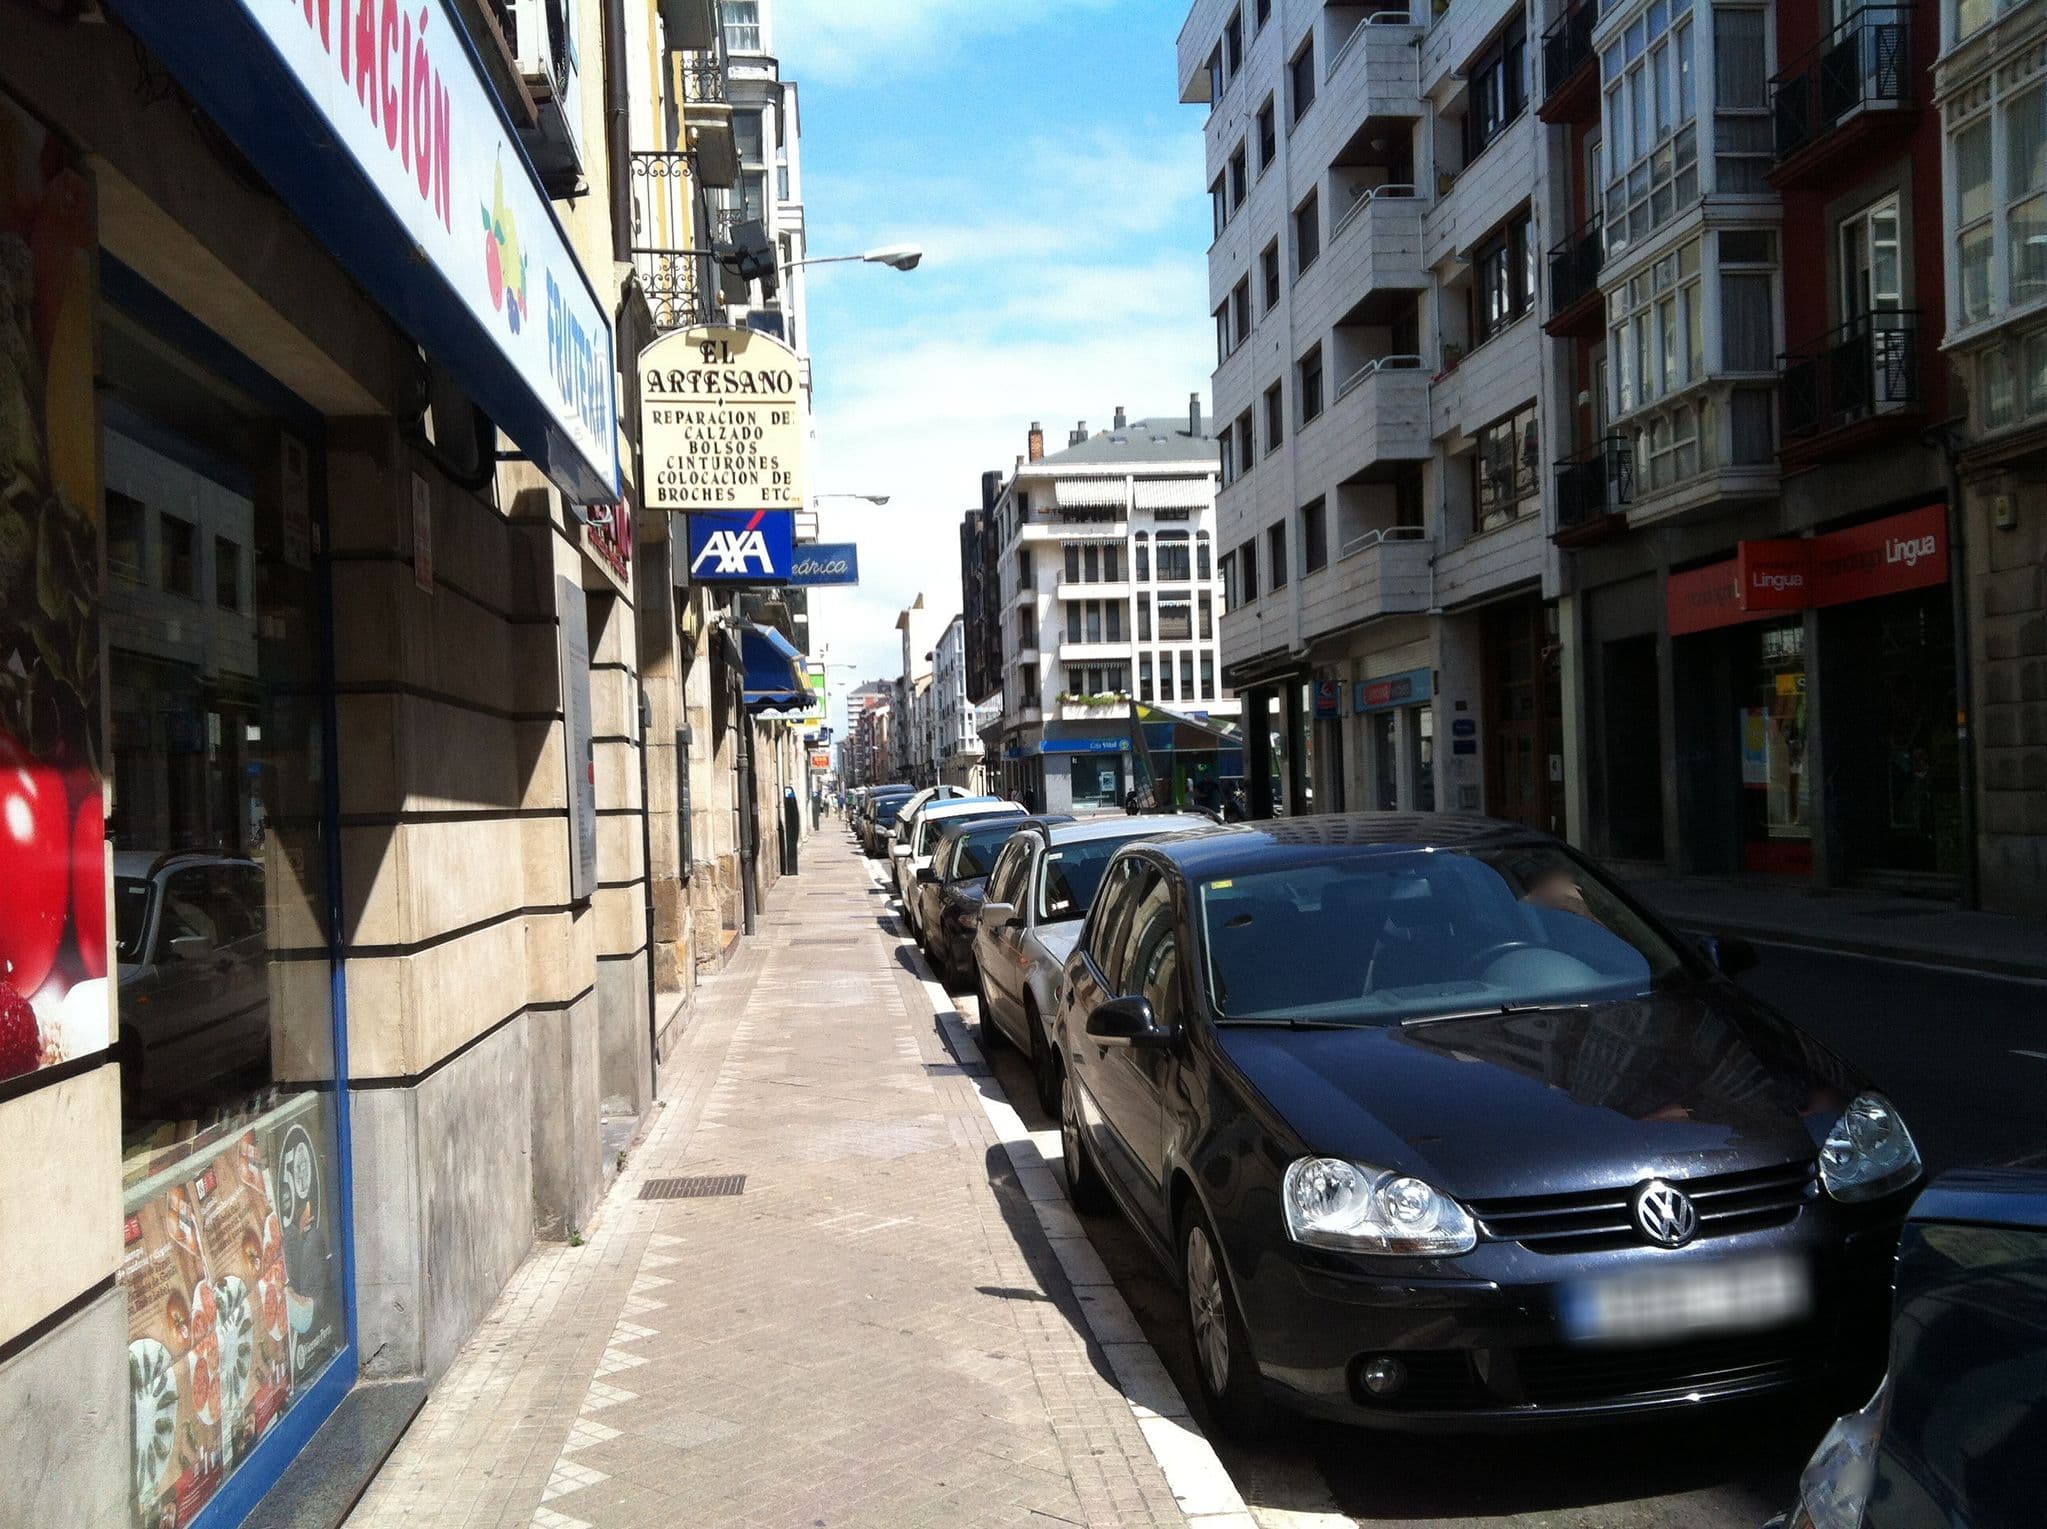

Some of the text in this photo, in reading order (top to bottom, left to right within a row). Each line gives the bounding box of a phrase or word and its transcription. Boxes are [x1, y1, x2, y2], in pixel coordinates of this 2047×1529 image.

[302, 0, 450, 235] ACIÓN
[700, 340, 736, 365] EL
[646, 369, 793, 395] ARTESANO
[653, 411, 757, 426] REPARACION
[684, 426, 764, 441] CALZADO
[689, 440, 758, 455] BOLSOS
[666, 455, 780, 471] CINTURONES
[657, 471, 792, 486] COLOCACION DE
[657, 487, 736, 502] BROCHES
[690, 530, 775, 574] AXA
[1886, 534, 1937, 567] Lingua
[1752, 571, 1804, 591] Lingua
